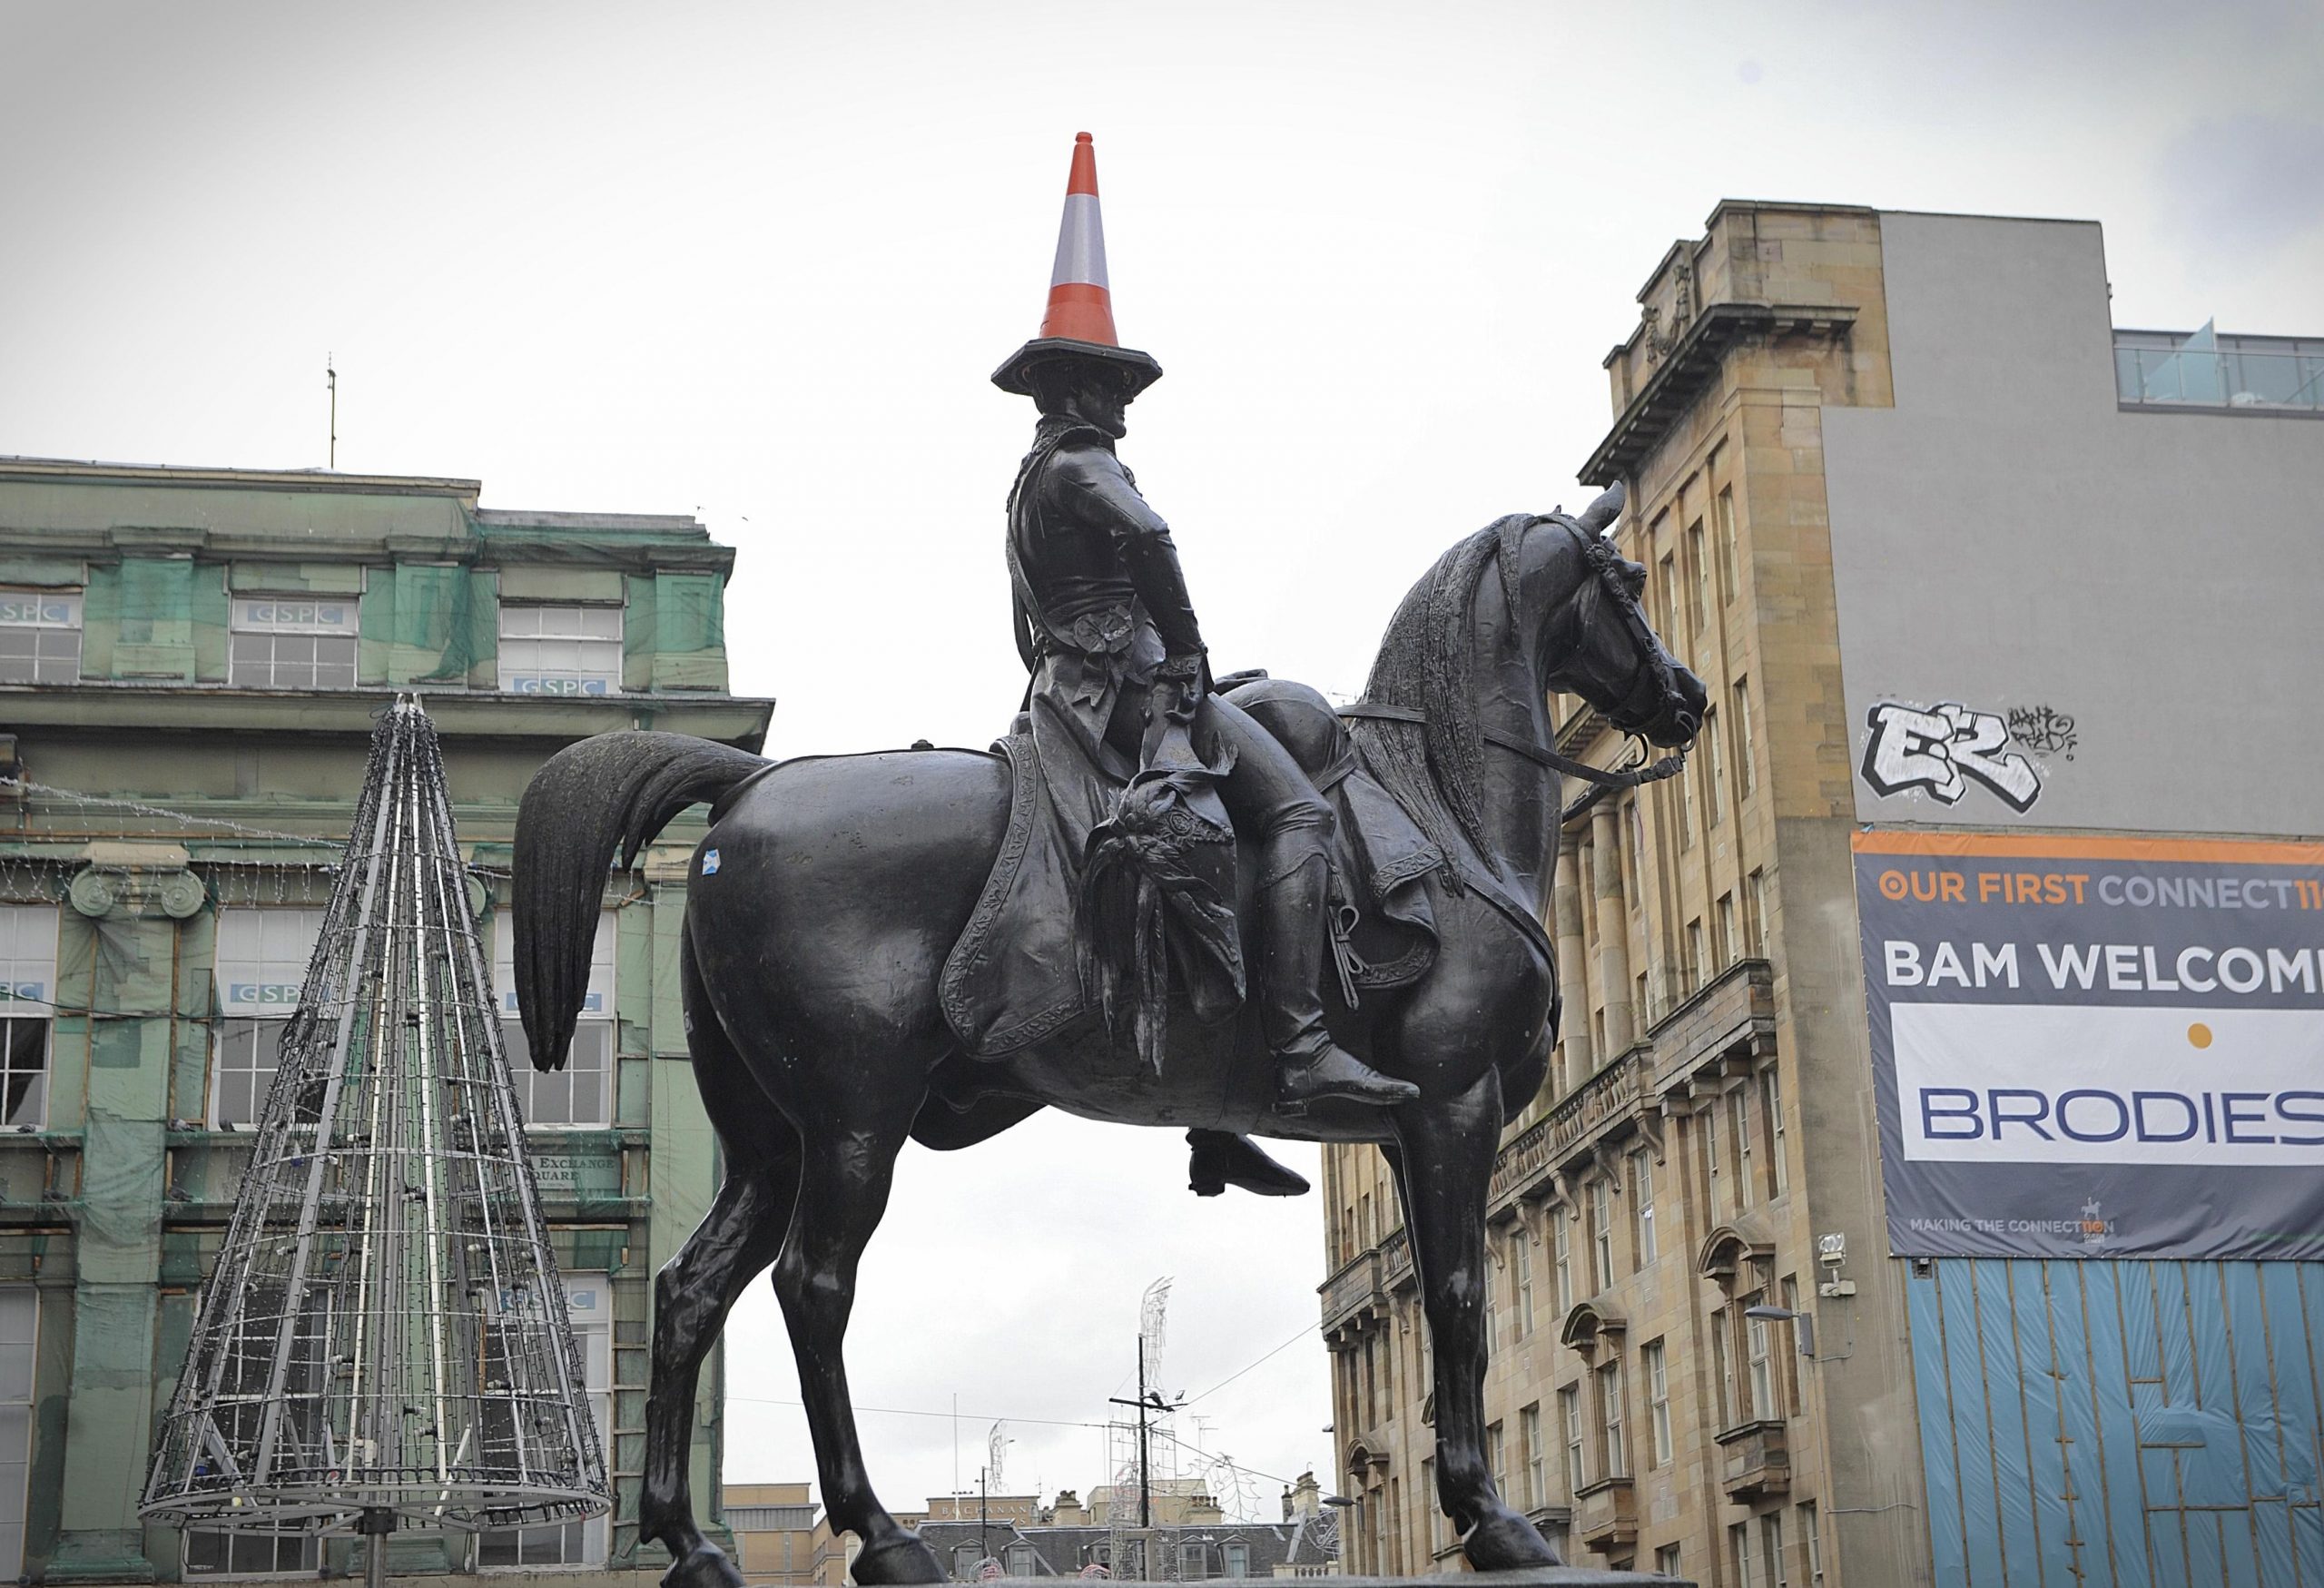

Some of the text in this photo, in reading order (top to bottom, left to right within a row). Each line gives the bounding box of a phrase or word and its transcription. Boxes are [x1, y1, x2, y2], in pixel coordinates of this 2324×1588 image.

[256, 606, 335, 623] GSPC
[522, 679, 597, 695] GSPC
[1878, 870, 1966, 902] OUR
[1978, 873, 2090, 904] FIRST
[1884, 940, 2324, 994] BAM WELCOM
[239, 986, 300, 1002] GSP
[1919, 1087, 2324, 1146] BRODIES
[540, 1157, 615, 1169] EXCHANGE
[524, 1170, 579, 1181] QUARE
[1910, 1218, 1971, 1232] MAKING
[1974, 1219, 2004, 1232] THE
